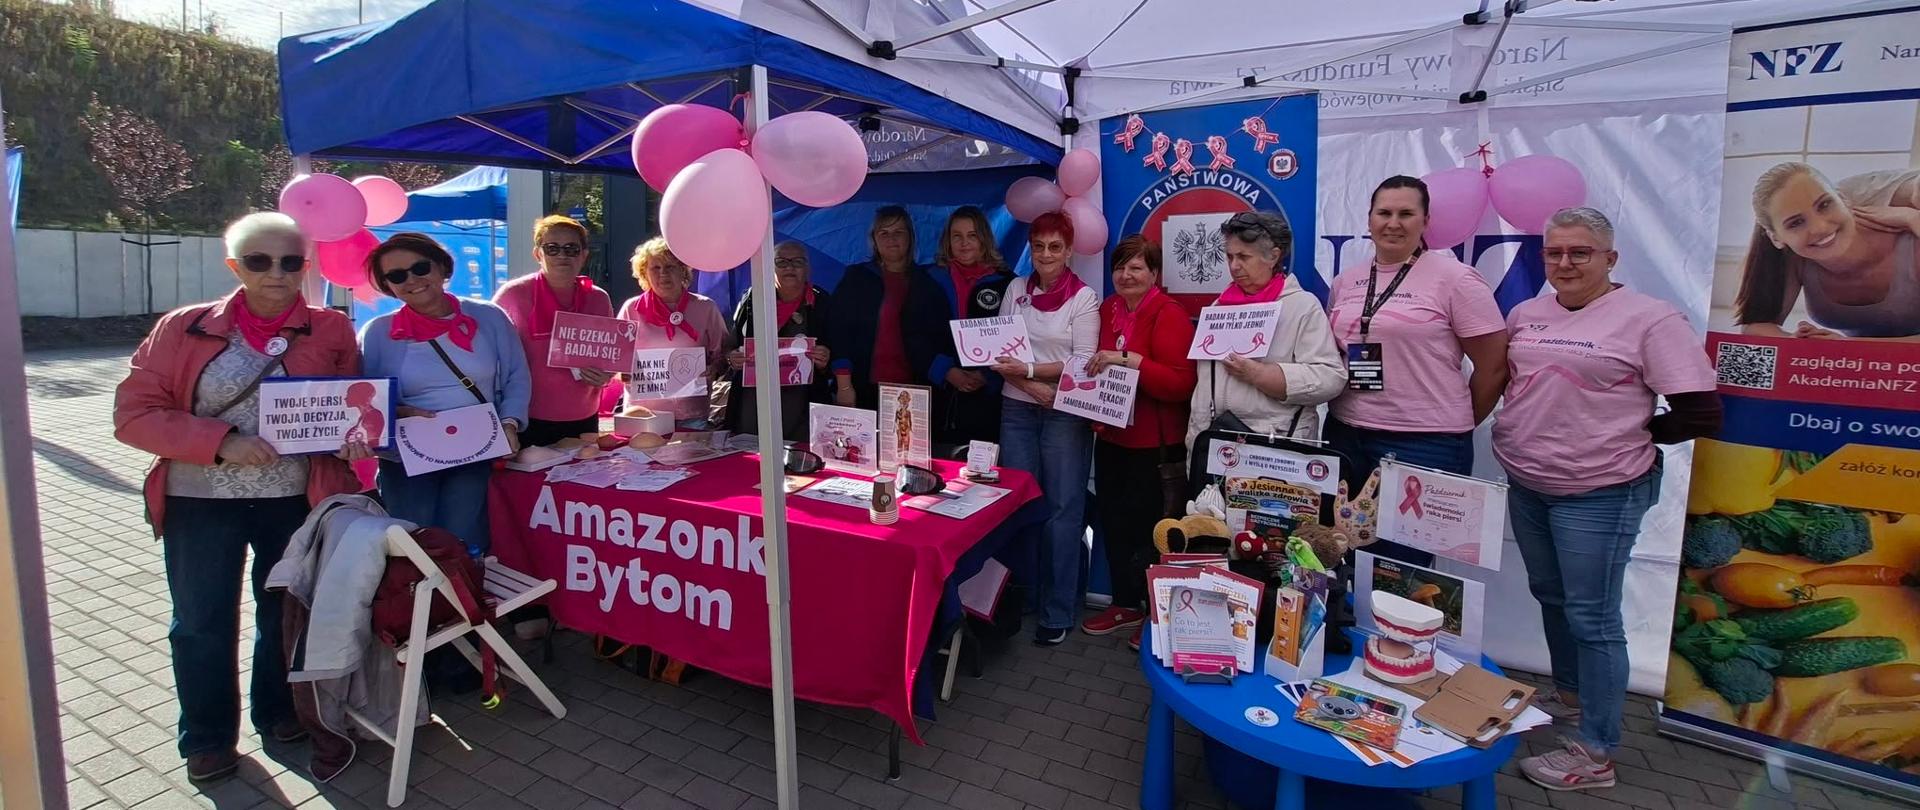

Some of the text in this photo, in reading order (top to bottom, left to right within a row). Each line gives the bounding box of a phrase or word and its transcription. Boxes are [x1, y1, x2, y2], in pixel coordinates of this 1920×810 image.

[1747, 41, 1844, 81] NFZ
[1141, 170, 1261, 211] PAŃSTWOWA
[960, 316, 1014, 328] BADANIE RATUJE
[1204, 312, 1226, 321] BADAM
[1239, 311, 1248, 319] BO
[1248, 309, 1276, 319] ZDROWIE
[1209, 320, 1266, 330] MAM TYLKO JEDNO!
[559, 326, 617, 344] NIE CZEKAJ
[564, 342, 621, 363] BADAJ SIĘ!
[636, 360, 665, 369] RAK NIE
[1790, 355, 1863, 372] zaglądaj
[1868, 360, 1891, 371] na
[633, 371, 671, 381] MA SZANS
[1108, 368, 1127, 380] BIUST
[637, 383, 668, 394] ZE MNĄ!
[1106, 381, 1131, 395] TWOICH
[1788, 374, 1917, 393] AkademiaNFZ
[274, 396, 342, 408] TWOJE PIERSI
[1098, 391, 1126, 406] RĘKACH!
[1063, 397, 1101, 413] SAMOBADANIE
[1101, 407, 1124, 420] RATUJE!
[265, 413, 300, 424] TWOJA
[276, 426, 340, 440] TWOJE ŻYCIE
[1789, 413, 1920, 442] Dbaj o swo
[1839, 461, 1888, 476] załóż
[1250, 481, 1296, 494] Jesienna
[1272, 493, 1309, 504] zdrowia
[1423, 502, 1466, 517] świadomości
[1426, 510, 1462, 522] raka piersi
[529, 485, 770, 576] Amazonk
[566, 544, 733, 631] Bytom
[1175, 616, 1185, 625] Co
